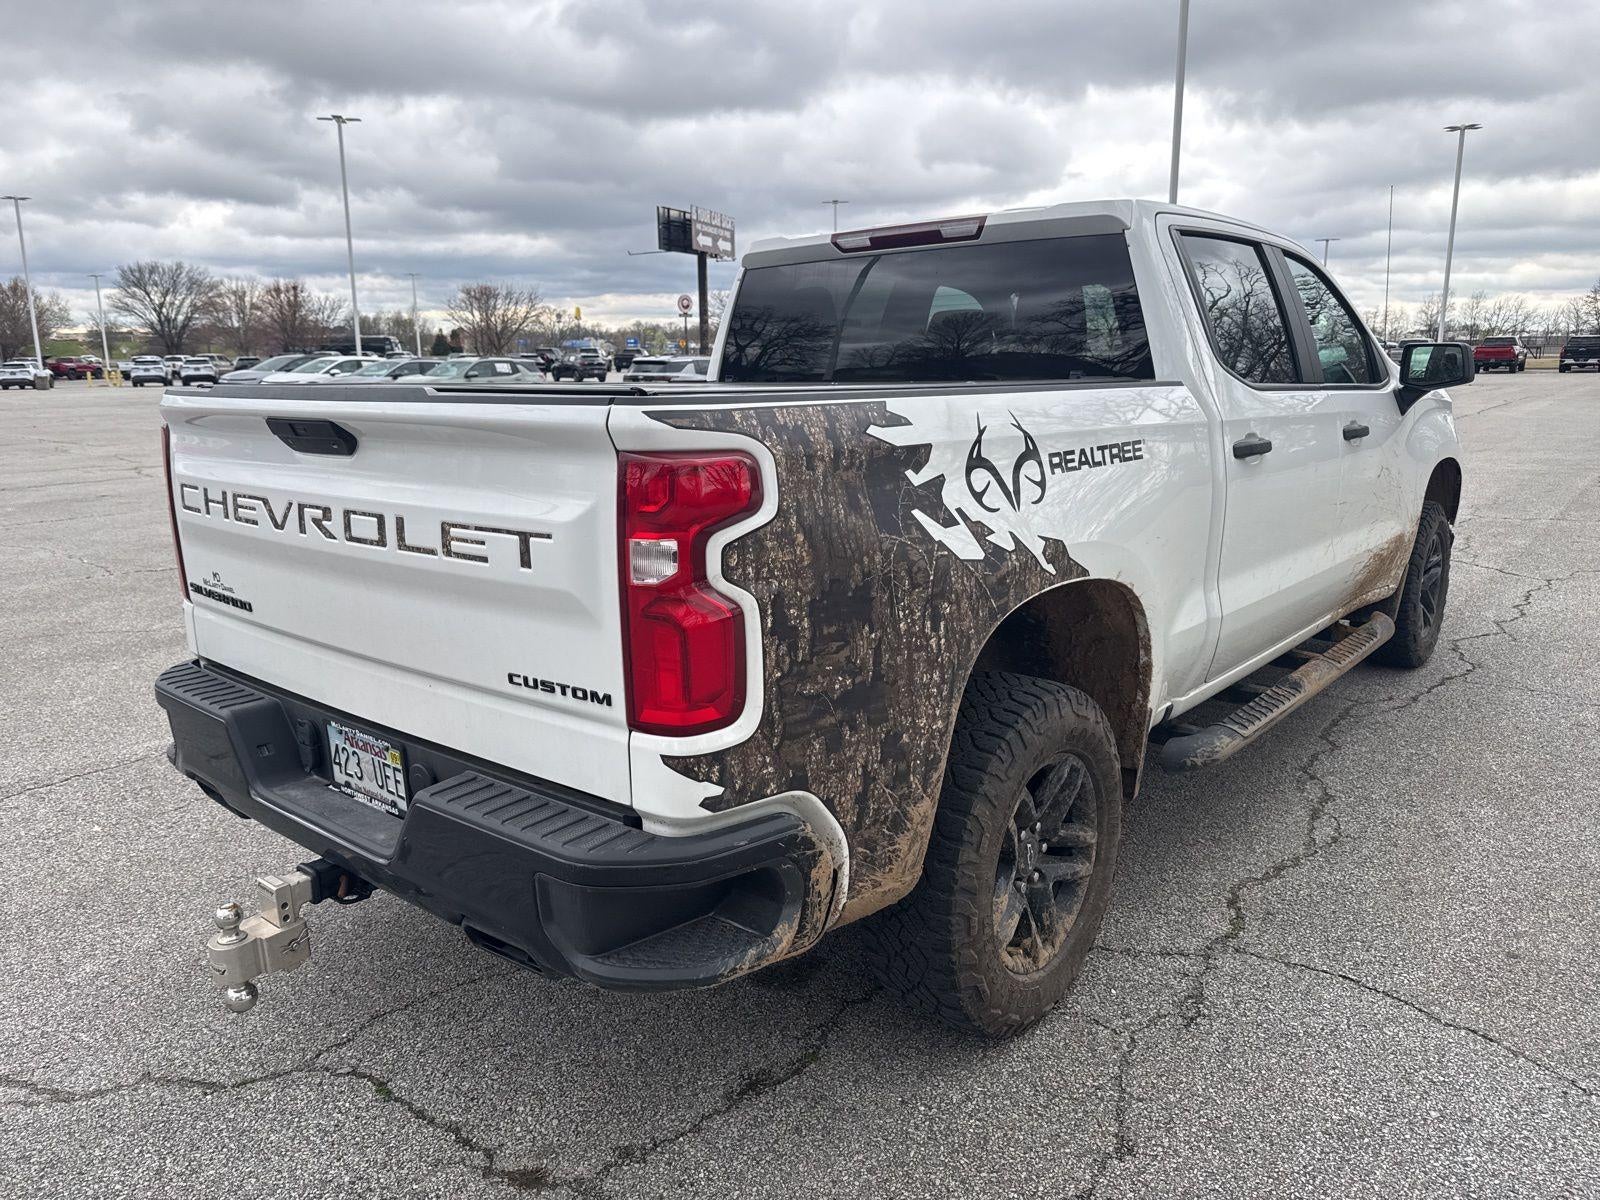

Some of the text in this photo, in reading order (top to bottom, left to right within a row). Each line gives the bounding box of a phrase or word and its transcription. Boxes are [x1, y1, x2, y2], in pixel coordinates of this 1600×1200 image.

[1048, 440, 1143, 475] REALTREE
[180, 483, 553, 570] CHEVROLET
[189, 581, 253, 612] SILVERADO
[507, 672, 612, 707] CUSTOM
[344, 730, 387, 761] Arkansas
[334, 743, 363, 781] 423
[371, 756, 405, 801] UEE
[371, 798, 399, 815] ARKANSAS
